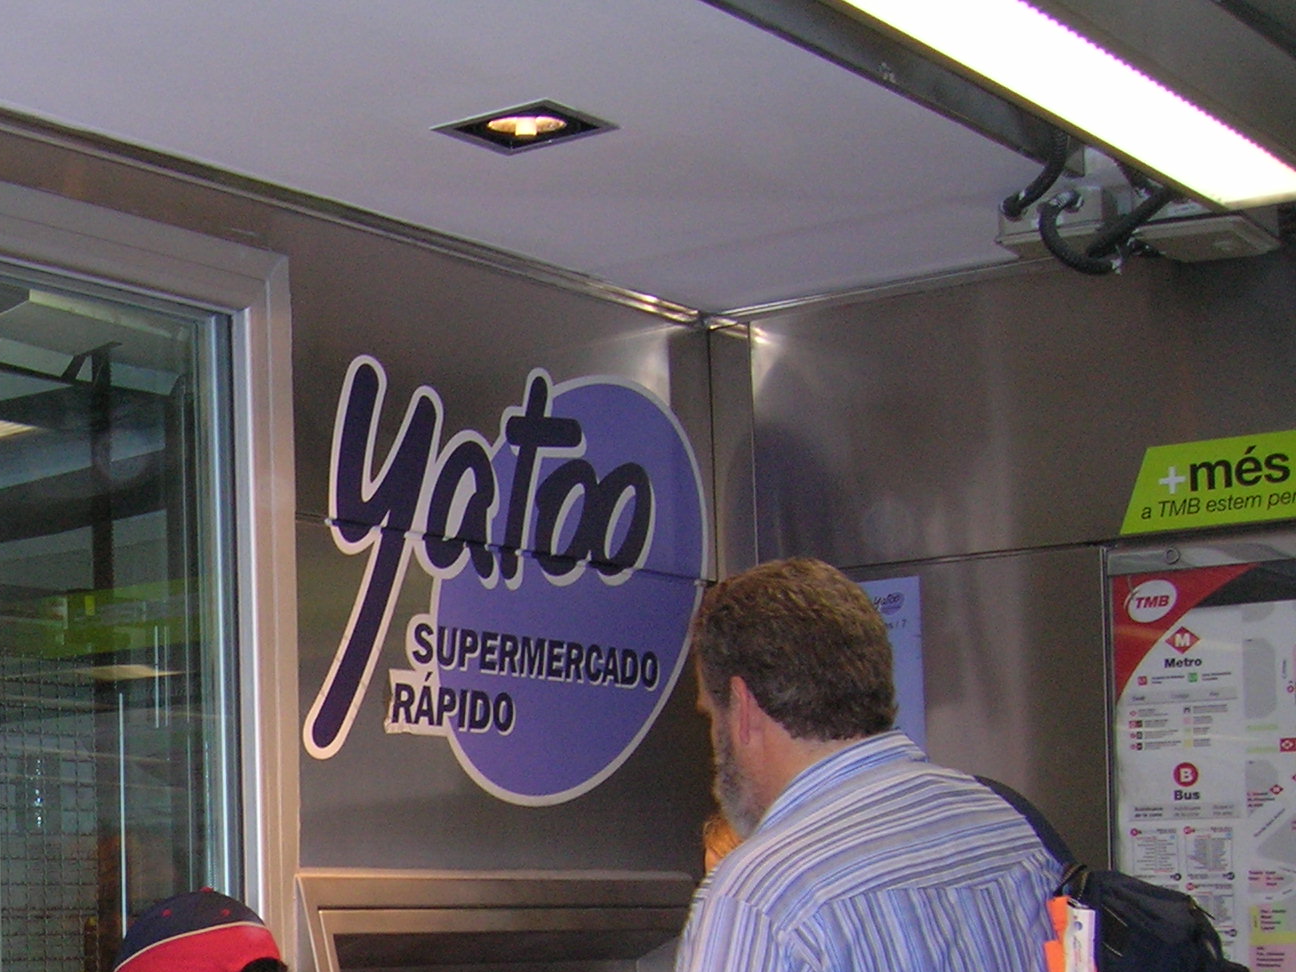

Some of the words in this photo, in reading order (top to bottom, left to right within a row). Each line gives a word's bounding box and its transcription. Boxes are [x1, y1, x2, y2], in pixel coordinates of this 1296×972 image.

[1141, 504, 1152, 519] a
[1159, 498, 1201, 517] TMB
[1206, 494, 1262, 513] estem
[1135, 596, 1170, 609] TMB
[412, 622, 660, 691] SUPERMERCADO
[1164, 658, 1203, 669] Metro
[391, 672, 516, 733] RÁPIDO
[1179, 769, 1193, 784] B
[1173, 789, 1201, 800] Bus
